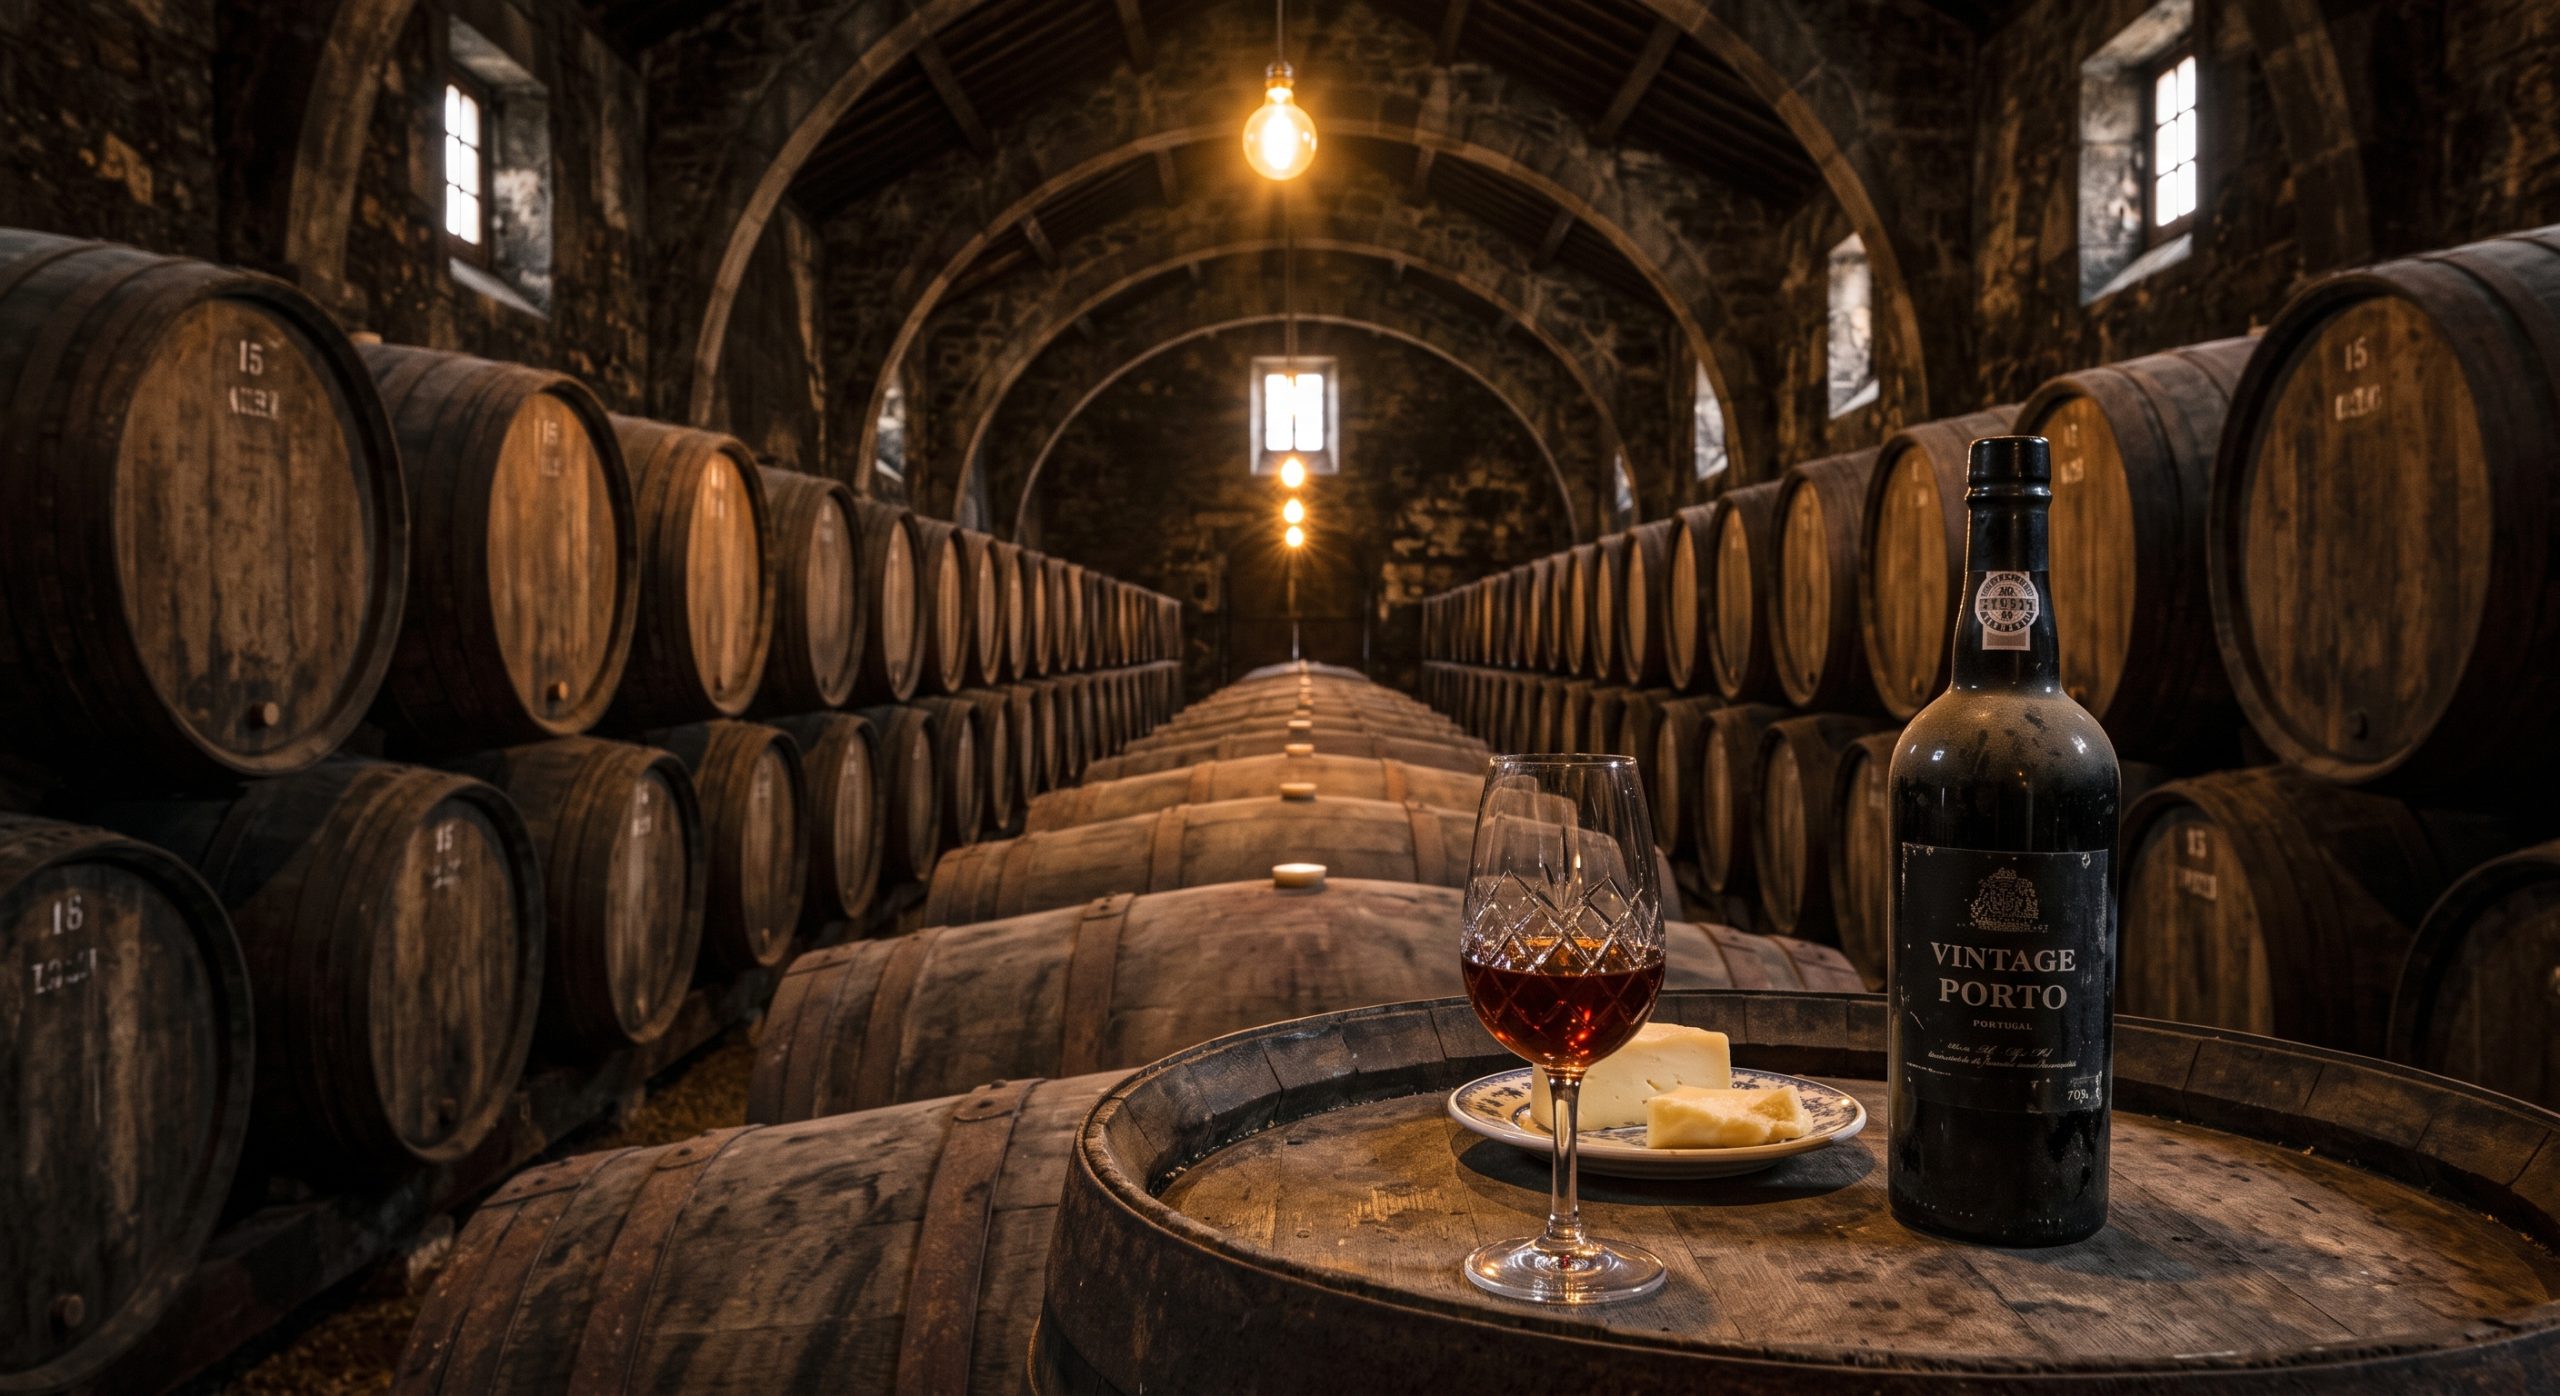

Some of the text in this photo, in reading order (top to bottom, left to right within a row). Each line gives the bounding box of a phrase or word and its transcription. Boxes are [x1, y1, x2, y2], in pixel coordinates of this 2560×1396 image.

[239, 339, 264, 376] 15
[2345, 337, 2368, 372] 15
[1930, 941, 2076, 972] VINTAGE
[1938, 977, 2068, 1010] PORTO
[1973, 1019, 2033, 1031] PORTUGAL
